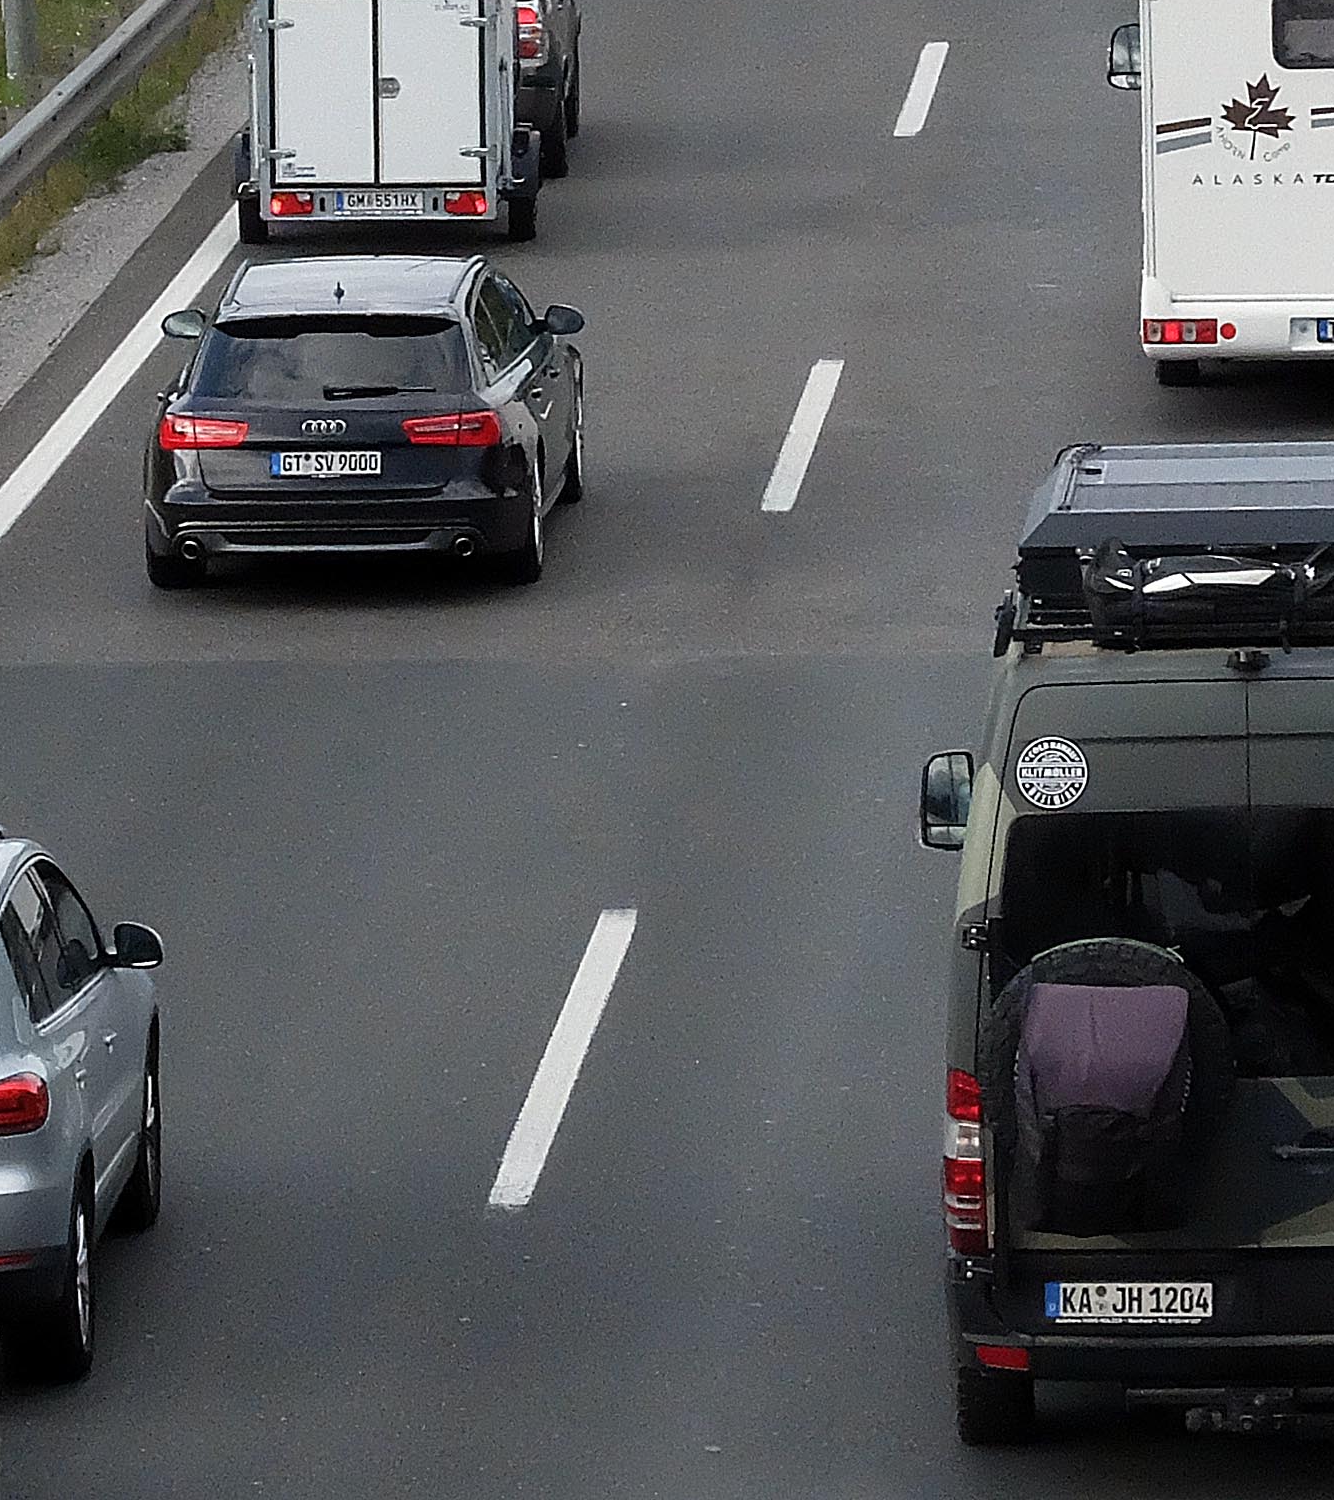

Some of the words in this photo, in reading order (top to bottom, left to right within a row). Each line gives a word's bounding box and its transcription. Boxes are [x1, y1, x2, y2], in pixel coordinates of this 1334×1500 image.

[1192, 173, 1305, 186] ALASKA
[347, 194, 365, 208] GM
[282, 453, 303, 472] GT
[314, 453, 334, 472] SV
[338, 453, 379, 472] 9000
[1062, 1287, 1092, 1314] KA
[1112, 1287, 1143, 1313] JH
[1149, 1286, 1210, 1313] 1204
